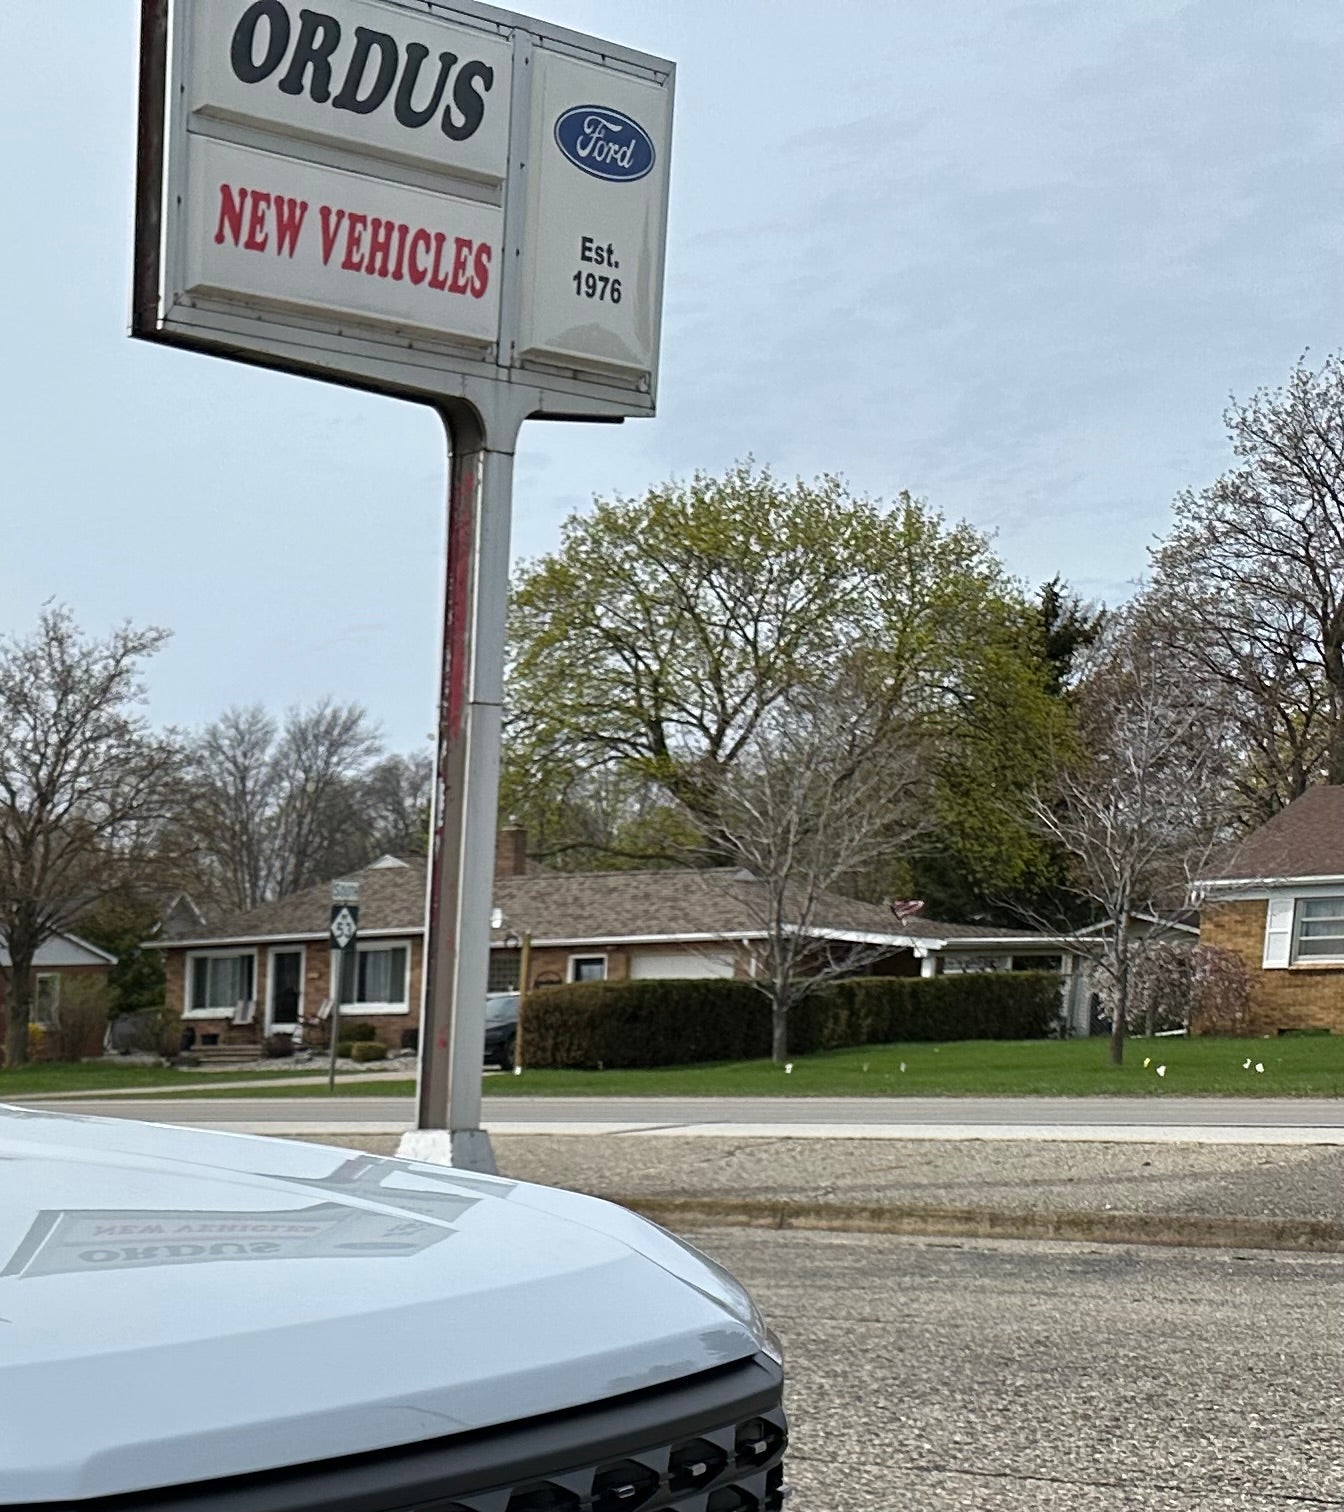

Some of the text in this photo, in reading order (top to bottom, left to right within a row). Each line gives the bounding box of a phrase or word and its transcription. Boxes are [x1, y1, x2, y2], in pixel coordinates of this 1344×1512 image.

[230, 0, 494, 142] ORDUS
[576, 114, 637, 169] Ford
[214, 183, 492, 299] NEW VEHICLES
[580, 235, 620, 269] Est.
[572, 270, 623, 305] 1976
